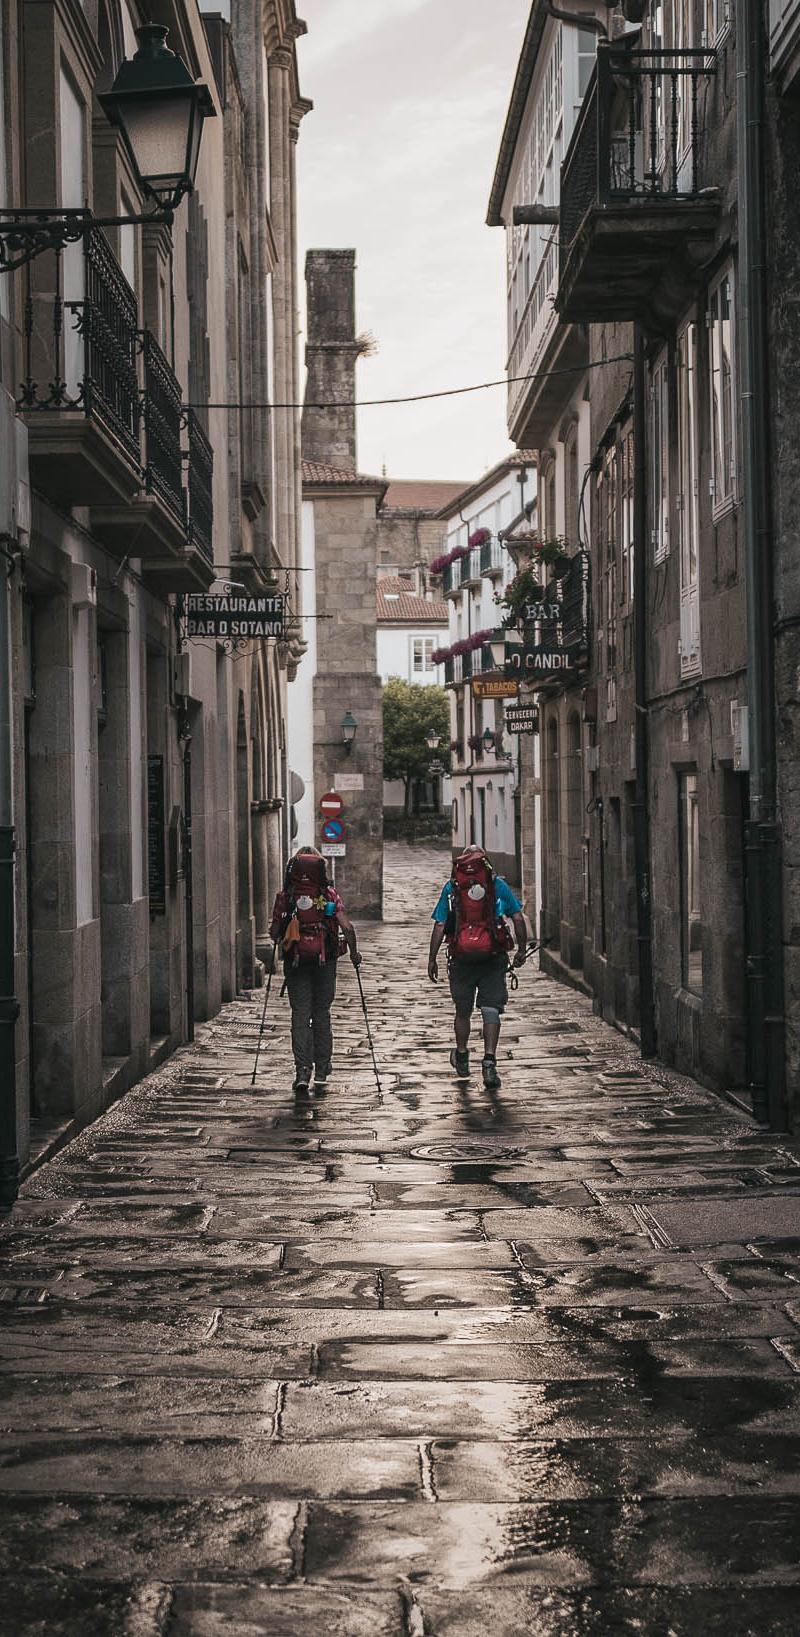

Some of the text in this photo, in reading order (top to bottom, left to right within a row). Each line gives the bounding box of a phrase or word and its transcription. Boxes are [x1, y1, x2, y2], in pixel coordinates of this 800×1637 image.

[188, 597, 283, 612] RESTAURANTE
[524, 604, 561, 619] BAR
[188, 620, 283, 635] BAR O SOTANO
[525, 653, 574, 669] CANDIL
[485, 681, 518, 692] TABACOS
[510, 721, 534, 731] DAKAR
